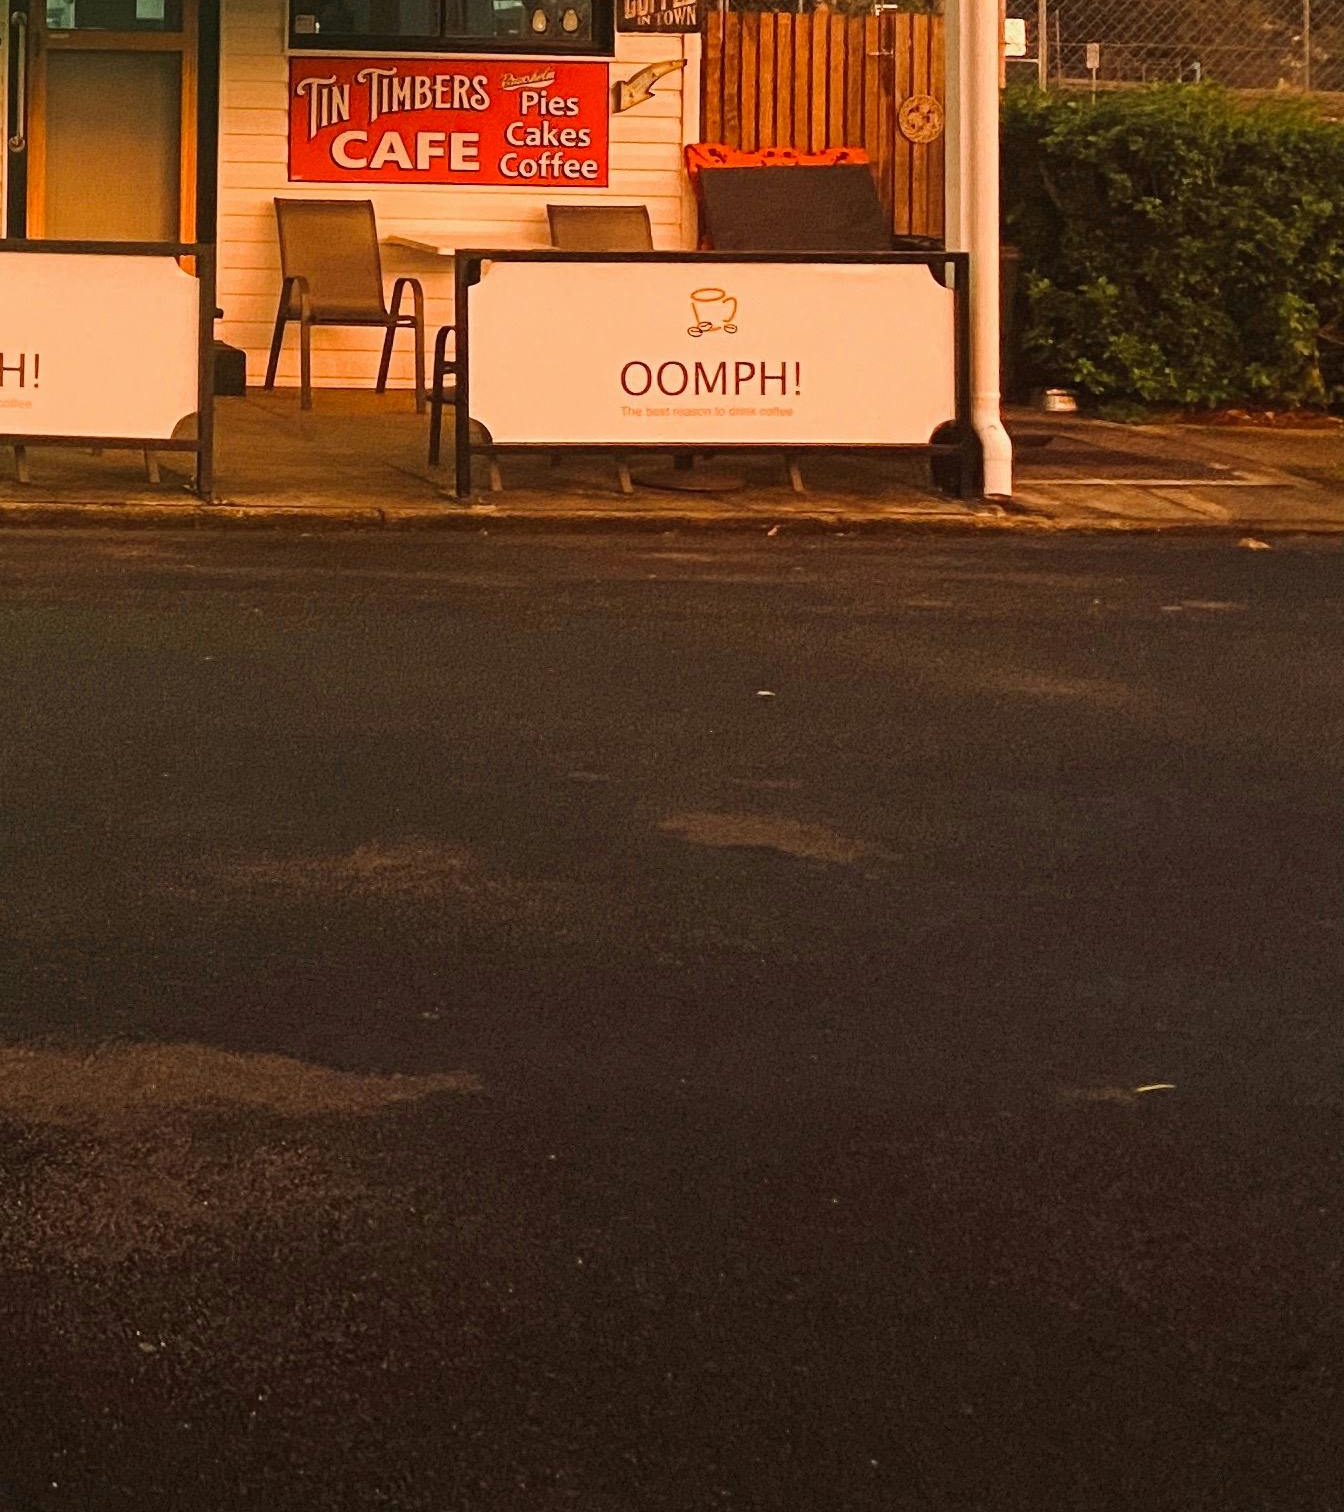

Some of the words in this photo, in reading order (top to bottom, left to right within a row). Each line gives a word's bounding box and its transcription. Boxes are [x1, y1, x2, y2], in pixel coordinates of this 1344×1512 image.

[656, 6, 697, 26] TOWN
[297, 74, 350, 139] TIN
[357, 66, 490, 123] TIMBERS
[520, 90, 580, 116] Pies
[506, 121, 592, 148] Cakes
[330, 131, 481, 171] CAFE
[499, 151, 599, 179] Coffee
[620, 360, 801, 396] OOMPH!
[621, 406, 643, 417] The
[645, 406, 670, 417] best
[672, 406, 712, 417] reason
[714, 406, 726, 417] to
